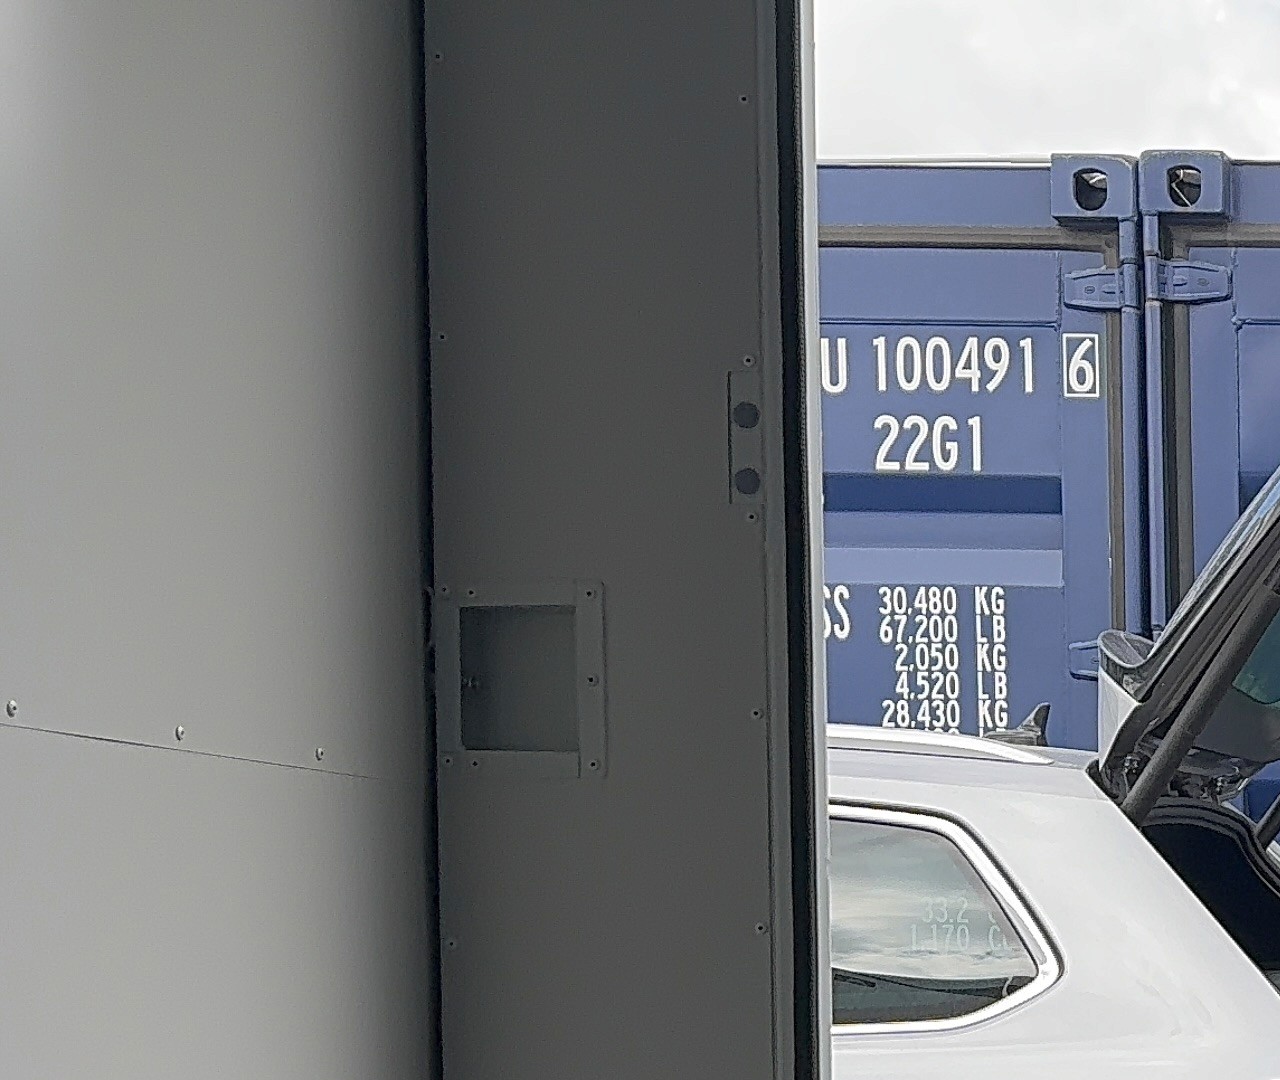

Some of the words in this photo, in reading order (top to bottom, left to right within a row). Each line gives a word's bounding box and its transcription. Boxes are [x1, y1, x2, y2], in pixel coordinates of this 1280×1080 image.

[872, 337, 1034, 393] 100491
[1069, 338, 1094, 391] 6
[874, 415, 982, 472] 22G1
[975, 586, 1005, 615] KG
[976, 615, 1006, 643] LB
[977, 644, 1007, 671] KG
[978, 672, 1007, 699] LB
[979, 700, 1008, 727] KG
